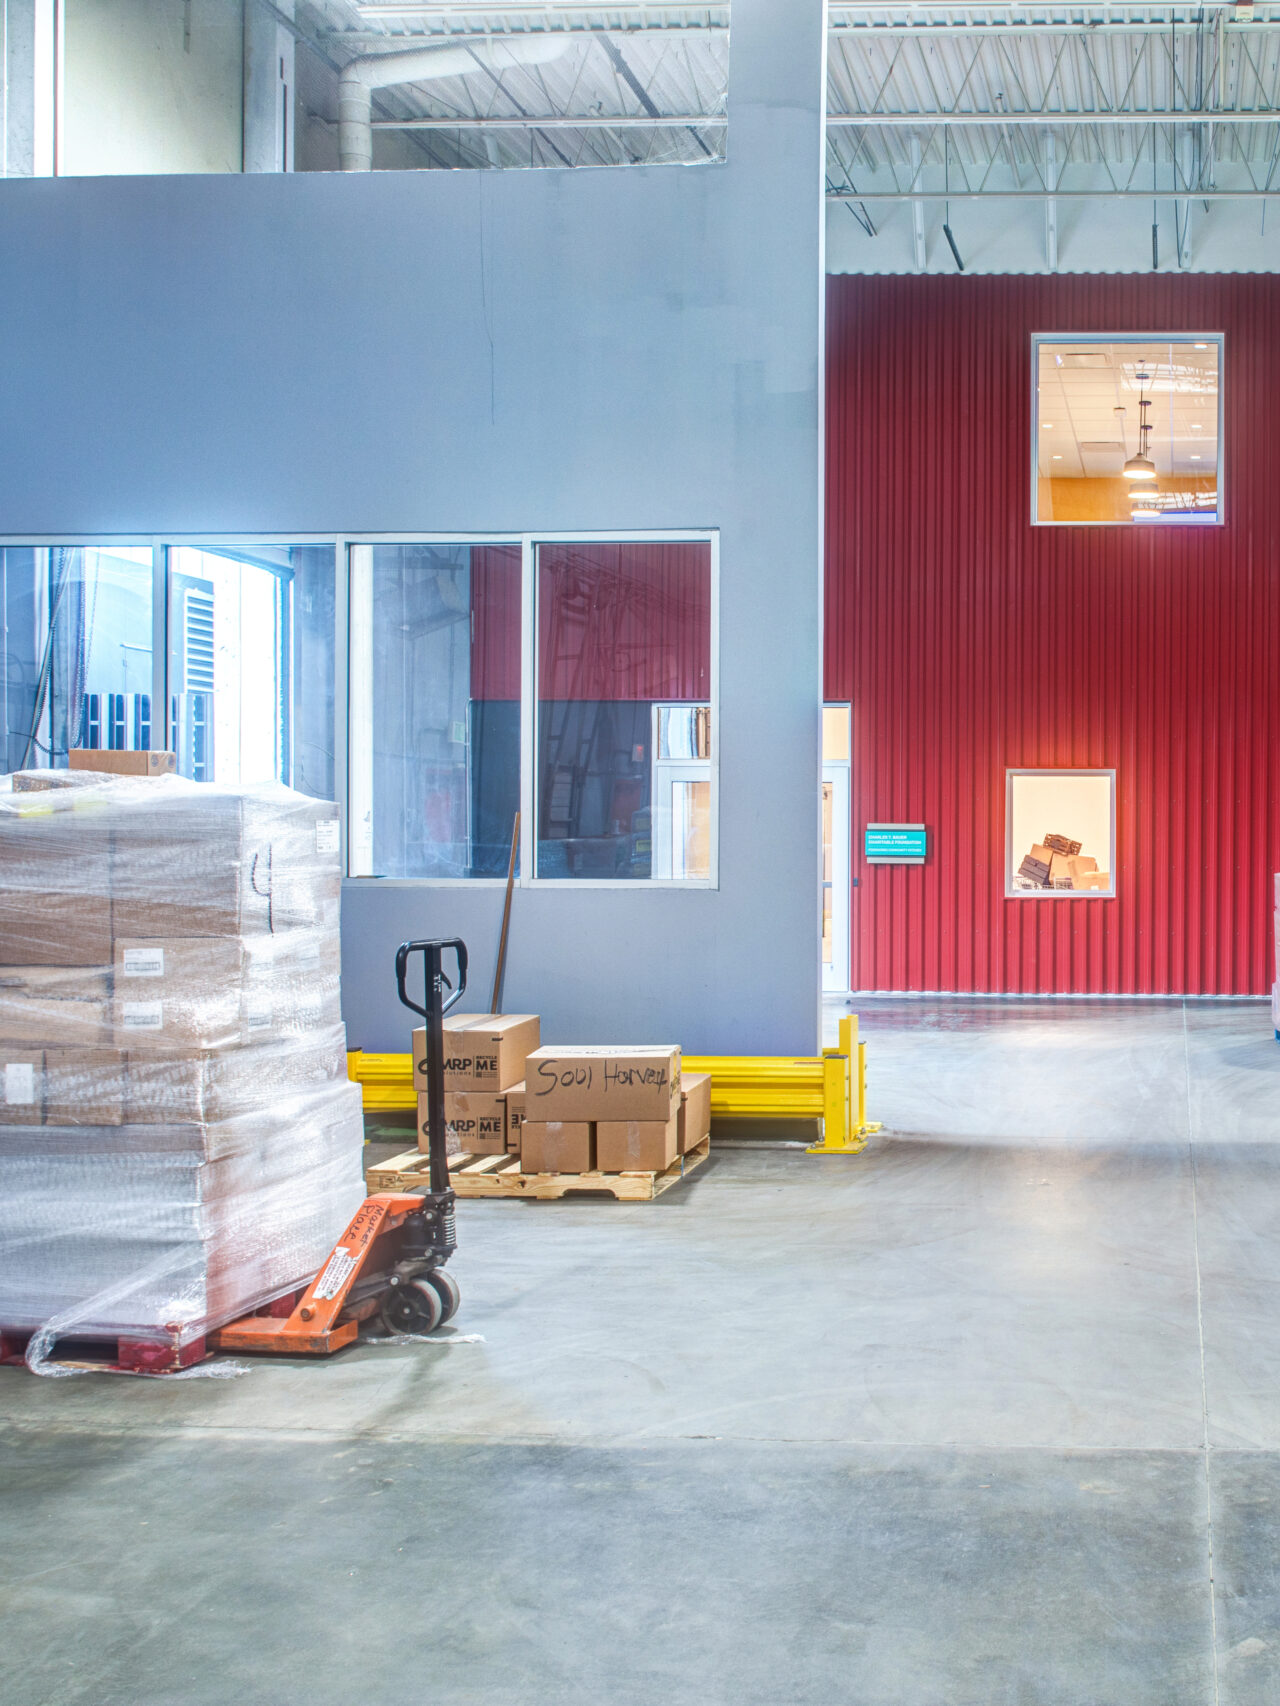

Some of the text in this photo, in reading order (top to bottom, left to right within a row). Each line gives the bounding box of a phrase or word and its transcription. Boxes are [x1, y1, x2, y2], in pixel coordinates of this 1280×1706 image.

[476, 1060, 498, 1071] ME
[535, 1059, 593, 1096] Soul
[480, 1121, 501, 1132] ME
